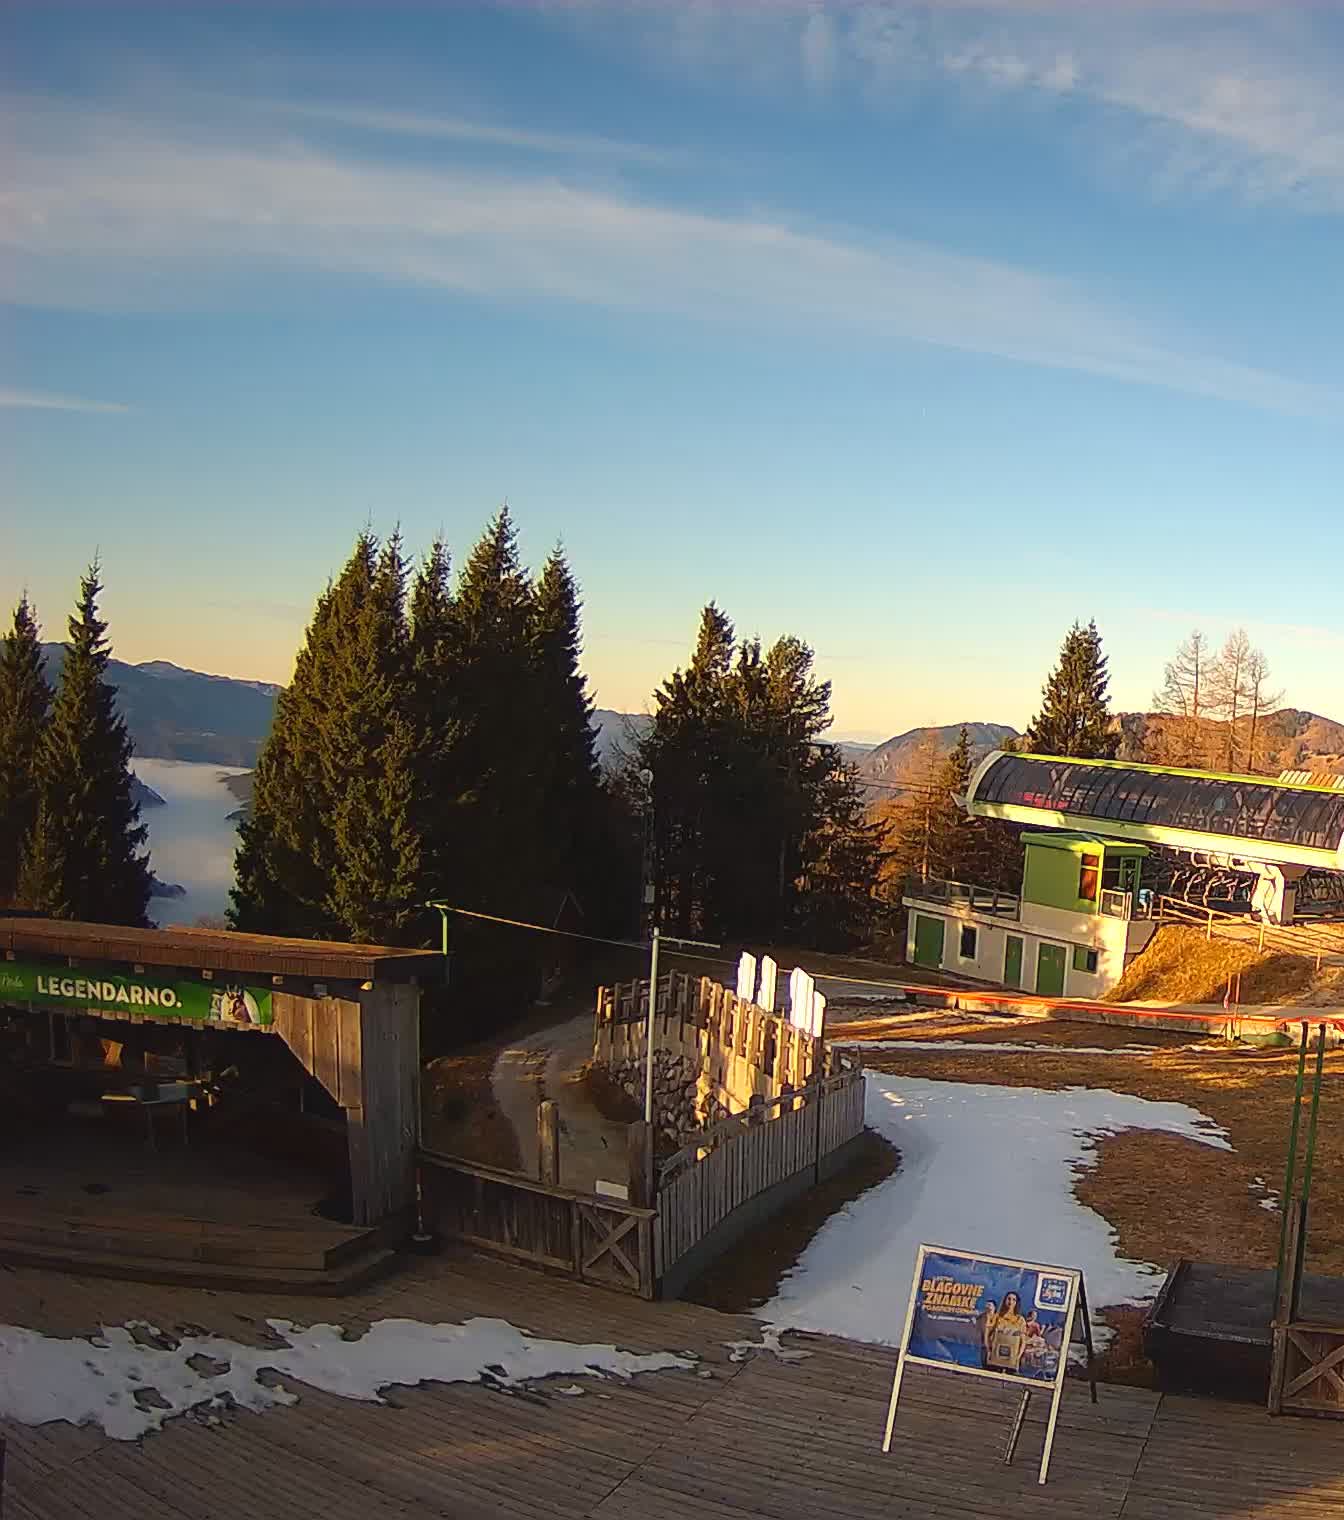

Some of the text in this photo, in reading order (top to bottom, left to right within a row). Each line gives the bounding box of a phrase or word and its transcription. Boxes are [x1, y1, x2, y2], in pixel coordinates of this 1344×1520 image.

[37, 975, 182, 1009] LEGENDARNO.
[922, 1279, 985, 1297] BLAGOVNE
[923, 1292, 978, 1309] ZNAMKE
